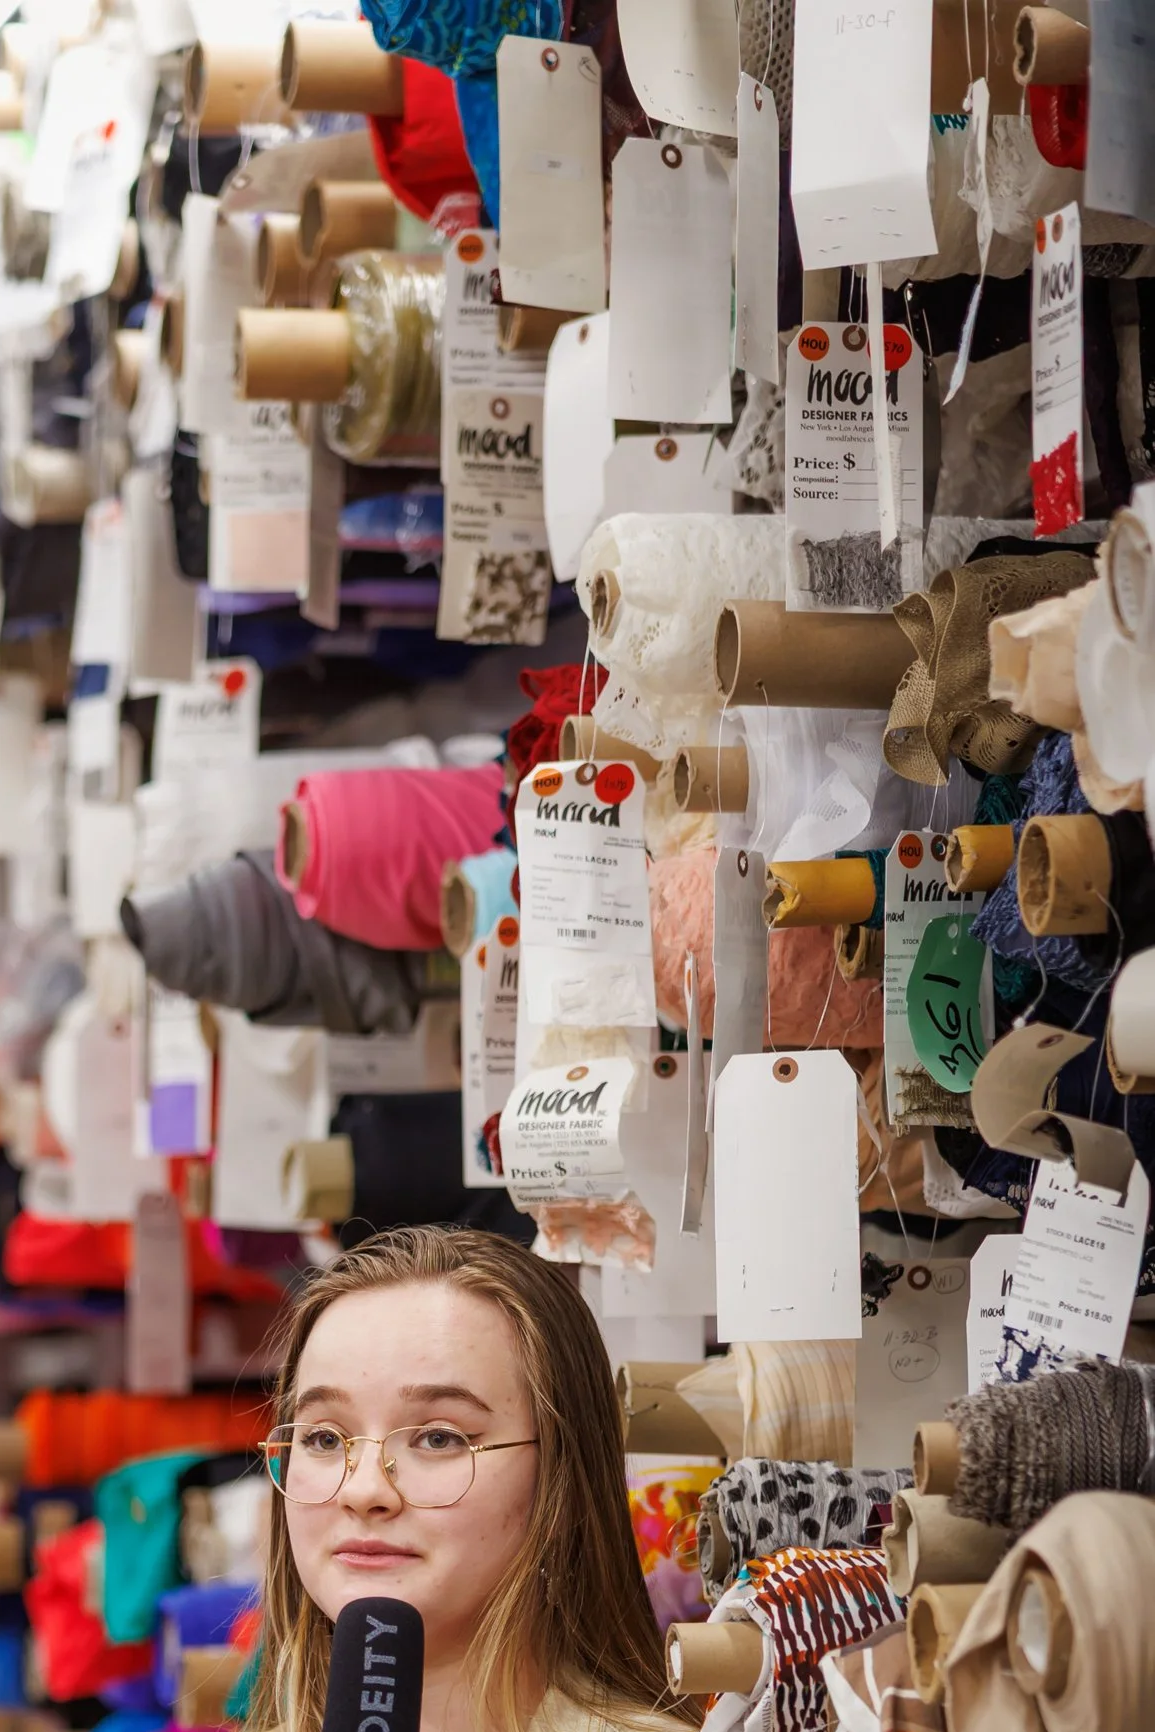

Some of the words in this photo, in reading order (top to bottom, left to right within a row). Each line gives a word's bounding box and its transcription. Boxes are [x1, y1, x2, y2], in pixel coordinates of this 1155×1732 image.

[800, 337, 827, 351] HOU
[801, 409, 858, 421] DESIGNER
[861, 411, 909, 422] FAICS
[800, 423, 814, 431] New
[817, 424, 832, 432] York
[793, 456, 839, 470] Price:
[843, 452, 856, 471] $
[792, 475, 839, 484] Composition:
[792, 487, 839, 500] Source:
[534, 776, 561, 789] HOU
[899, 846, 921, 857] HOU
[584, 855, 619, 867] LACE25
[587, 914, 612, 925] Price:
[614, 918, 644, 928] $25.00
[517, 1081, 608, 1118] mood
[517, 1120, 566, 1132] DESIGNER
[569, 1119, 604, 1129] FABRIC
[510, 1168, 553, 1180] Price:
[554, 1160, 567, 1177] $
[1033, 1195, 1056, 1211] mood
[1073, 1233, 1106, 1251] LACE18
[980, 1304, 1006, 1319] mood
[1058, 1300, 1083, 1315] Price:
[1084, 1307, 1113, 1325] $18.00
